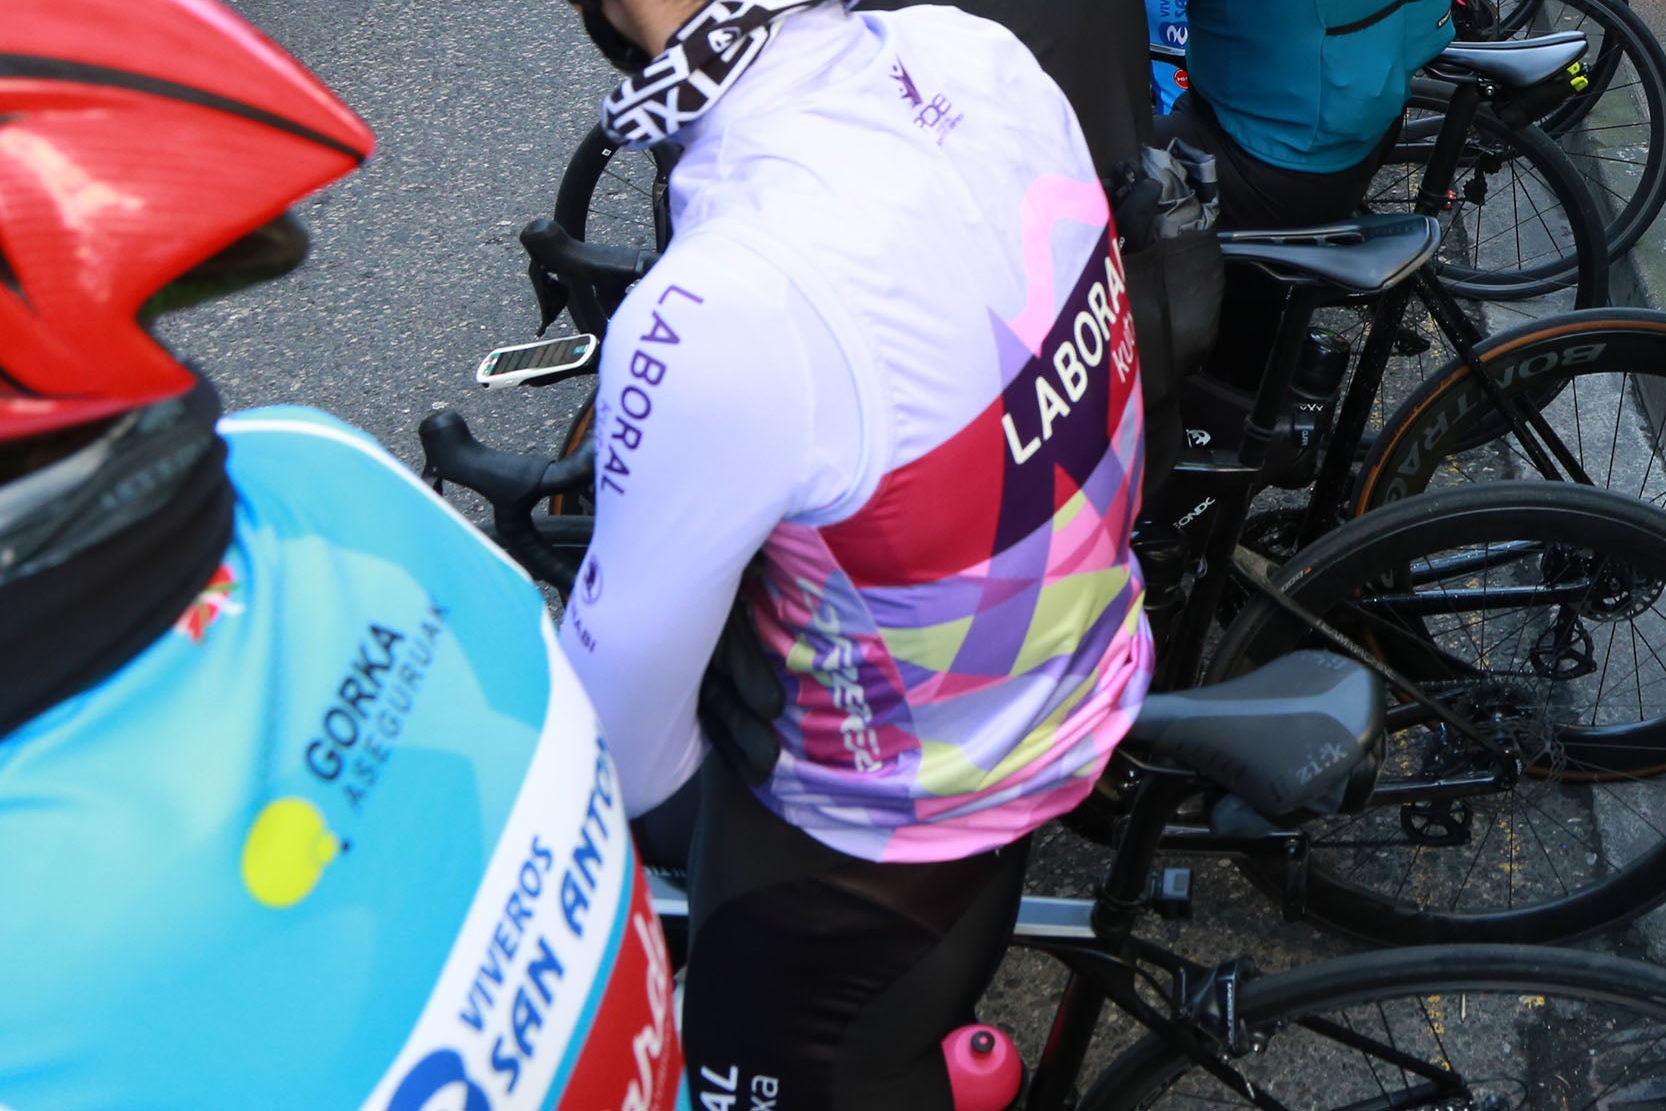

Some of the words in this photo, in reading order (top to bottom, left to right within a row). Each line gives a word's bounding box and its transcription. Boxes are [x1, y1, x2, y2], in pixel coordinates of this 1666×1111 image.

[600, 285, 704, 495] LABORAL
[305, 622, 406, 782] GORKA
[345, 599, 450, 812] ASEGURUAK
[459, 834, 556, 1035] VIVEROS
